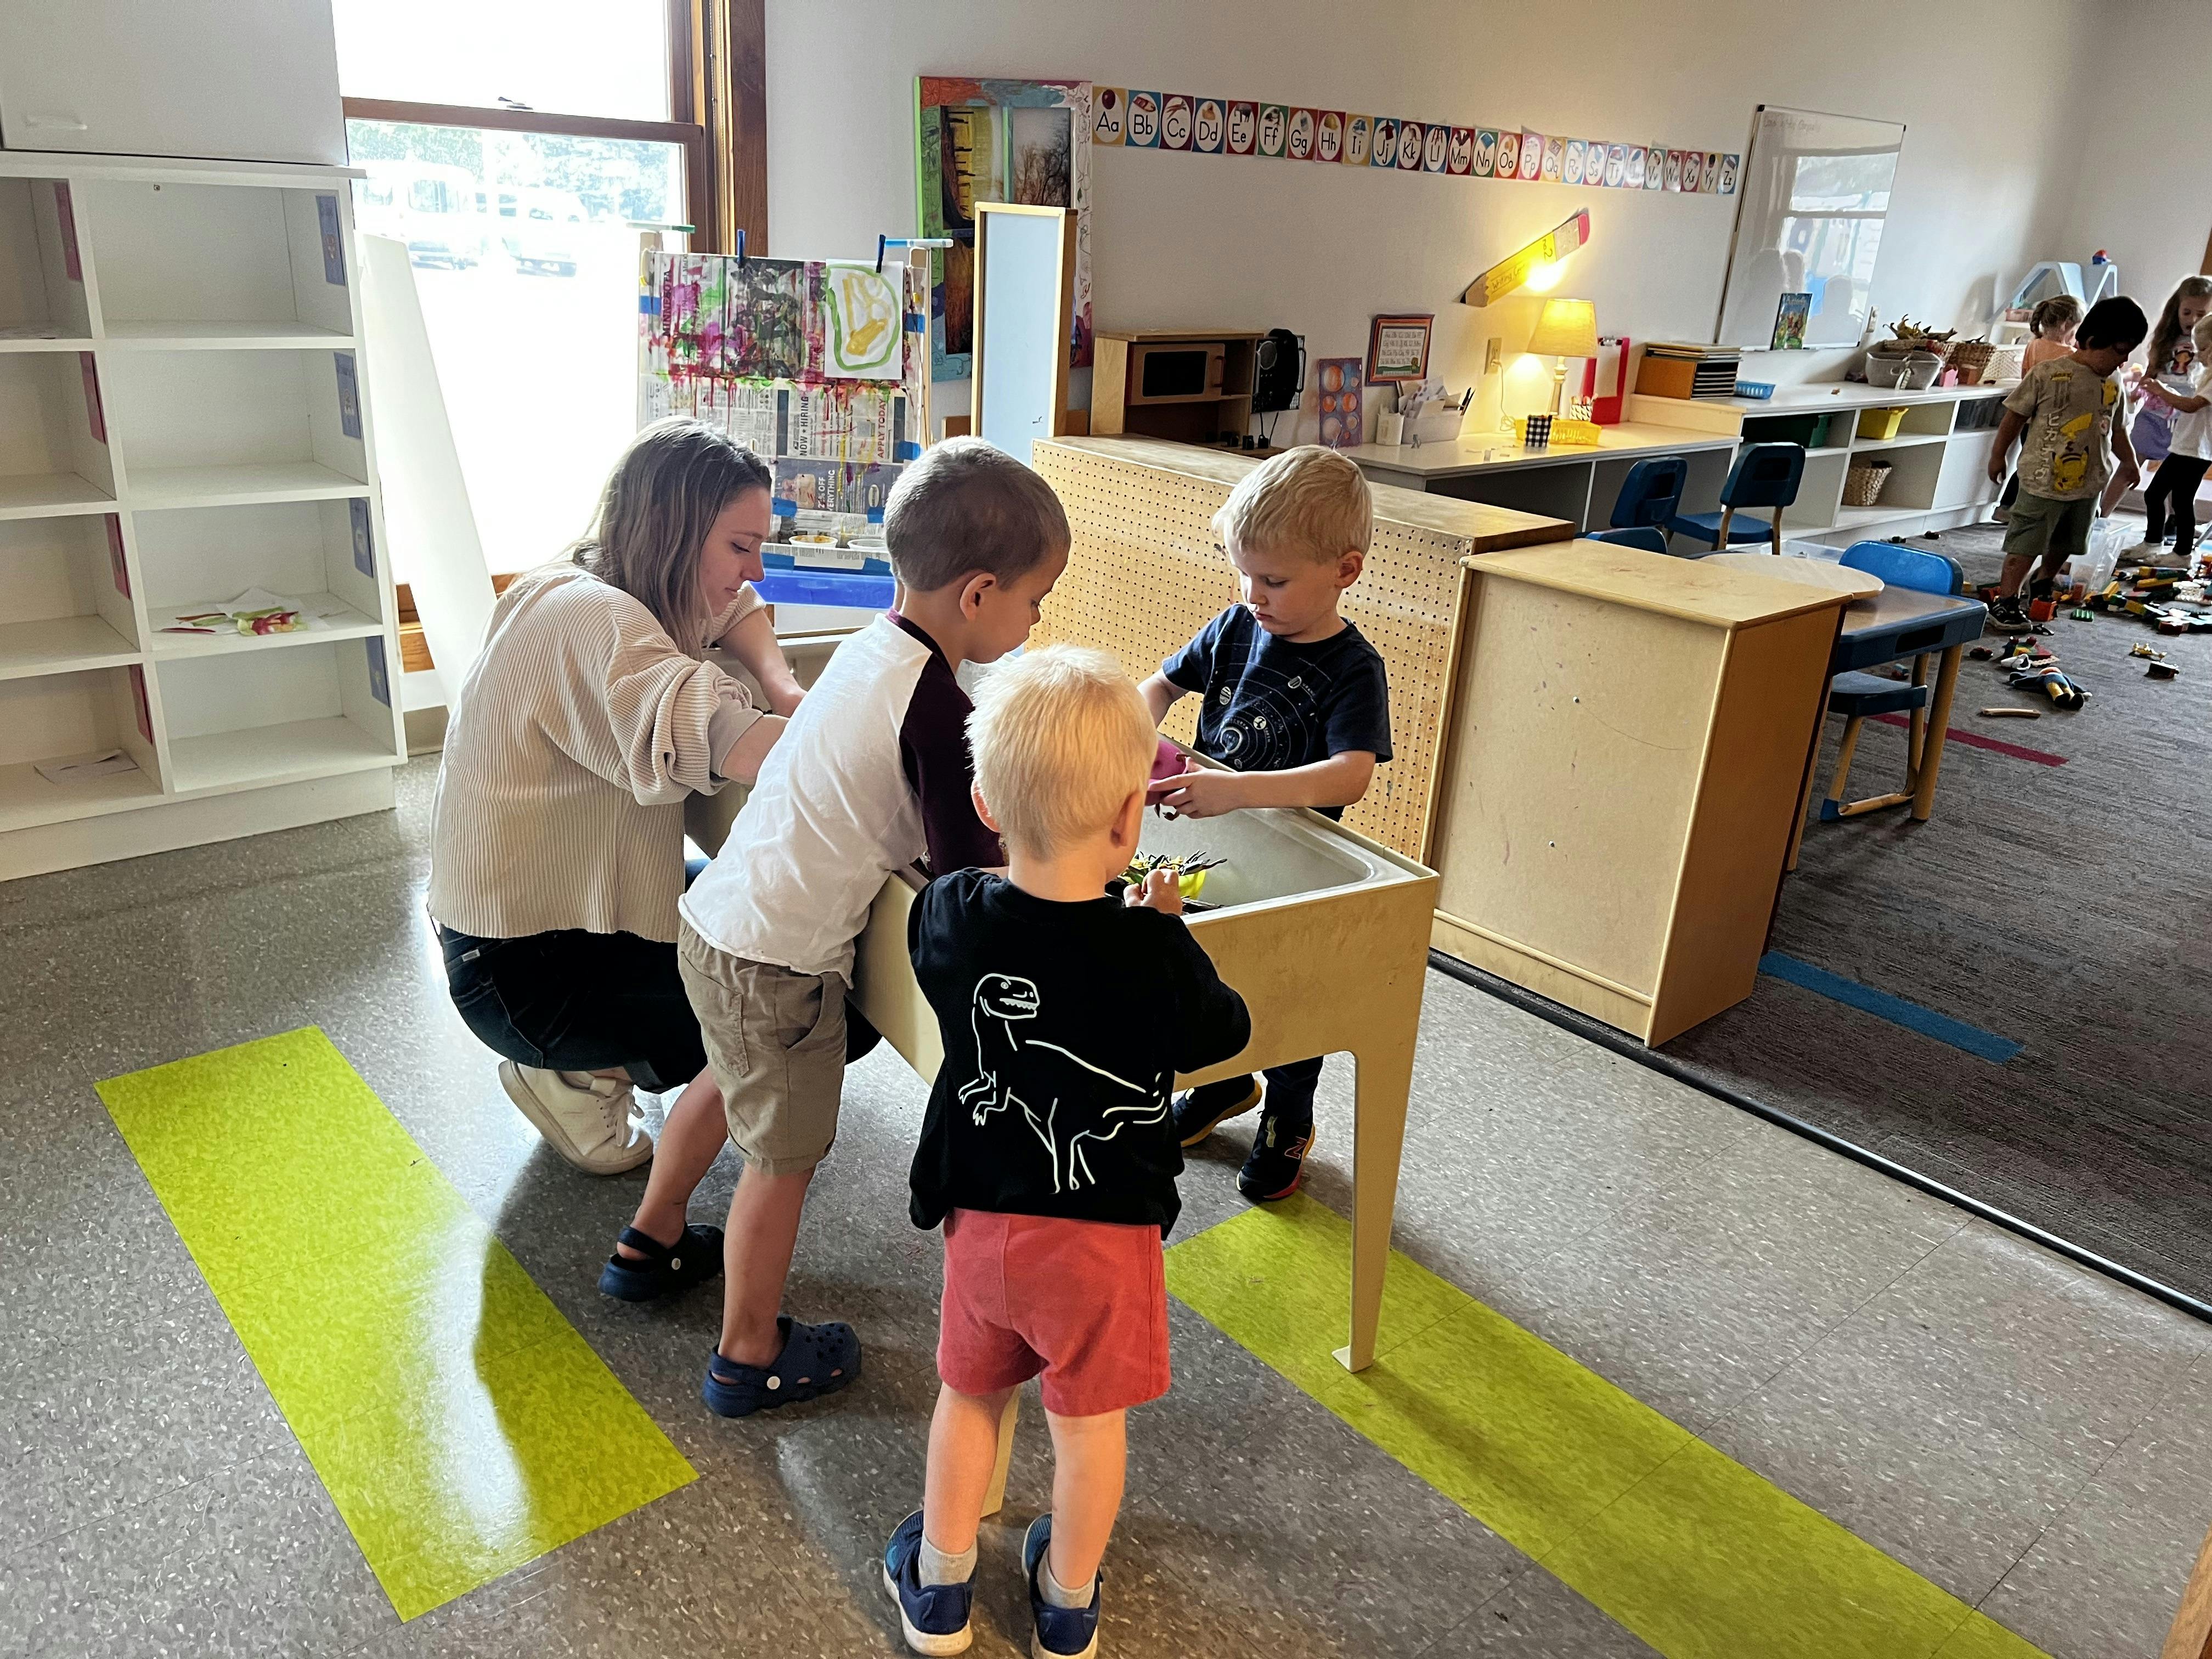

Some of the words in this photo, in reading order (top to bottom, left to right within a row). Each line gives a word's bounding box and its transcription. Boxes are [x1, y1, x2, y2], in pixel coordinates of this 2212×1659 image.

[1096, 111, 1119, 132] Aa
[1134, 114, 1153, 135] Bb
[1167, 118, 1186, 138] Cc
[1199, 121, 1217, 141] Dd
[1232, 123, 1246, 142] Ee
[1265, 127, 1278, 145] Ff
[1291, 129, 1307, 155] Gg
[1321, 132, 1336, 151] Hh
[1352, 136, 1361, 154] Ii
[1377, 139, 1389, 164] Jj
[1403, 142, 1415, 160] Kk
[1430, 144, 1440, 161] Ll
[1451, 148, 1468, 165] Mm
[1476, 150, 1489, 168] Nn
[1499, 153, 1513, 168] Oo
[1524, 154, 1535, 177] Pp
[1545, 156, 1558, 179] Qq
[1568, 159, 1578, 174] Rr
[1589, 161, 1598, 176] Ss
[1610, 162, 1619, 179] Tt
[1649, 166, 1658, 181] Vv
[1685, 168, 1694, 183] Xx
[1705, 170, 1713, 190] Yy
[1724, 171, 1732, 185] Zz
[800, 396, 809, 427] HIRING
[799, 436, 808, 456] NOW
